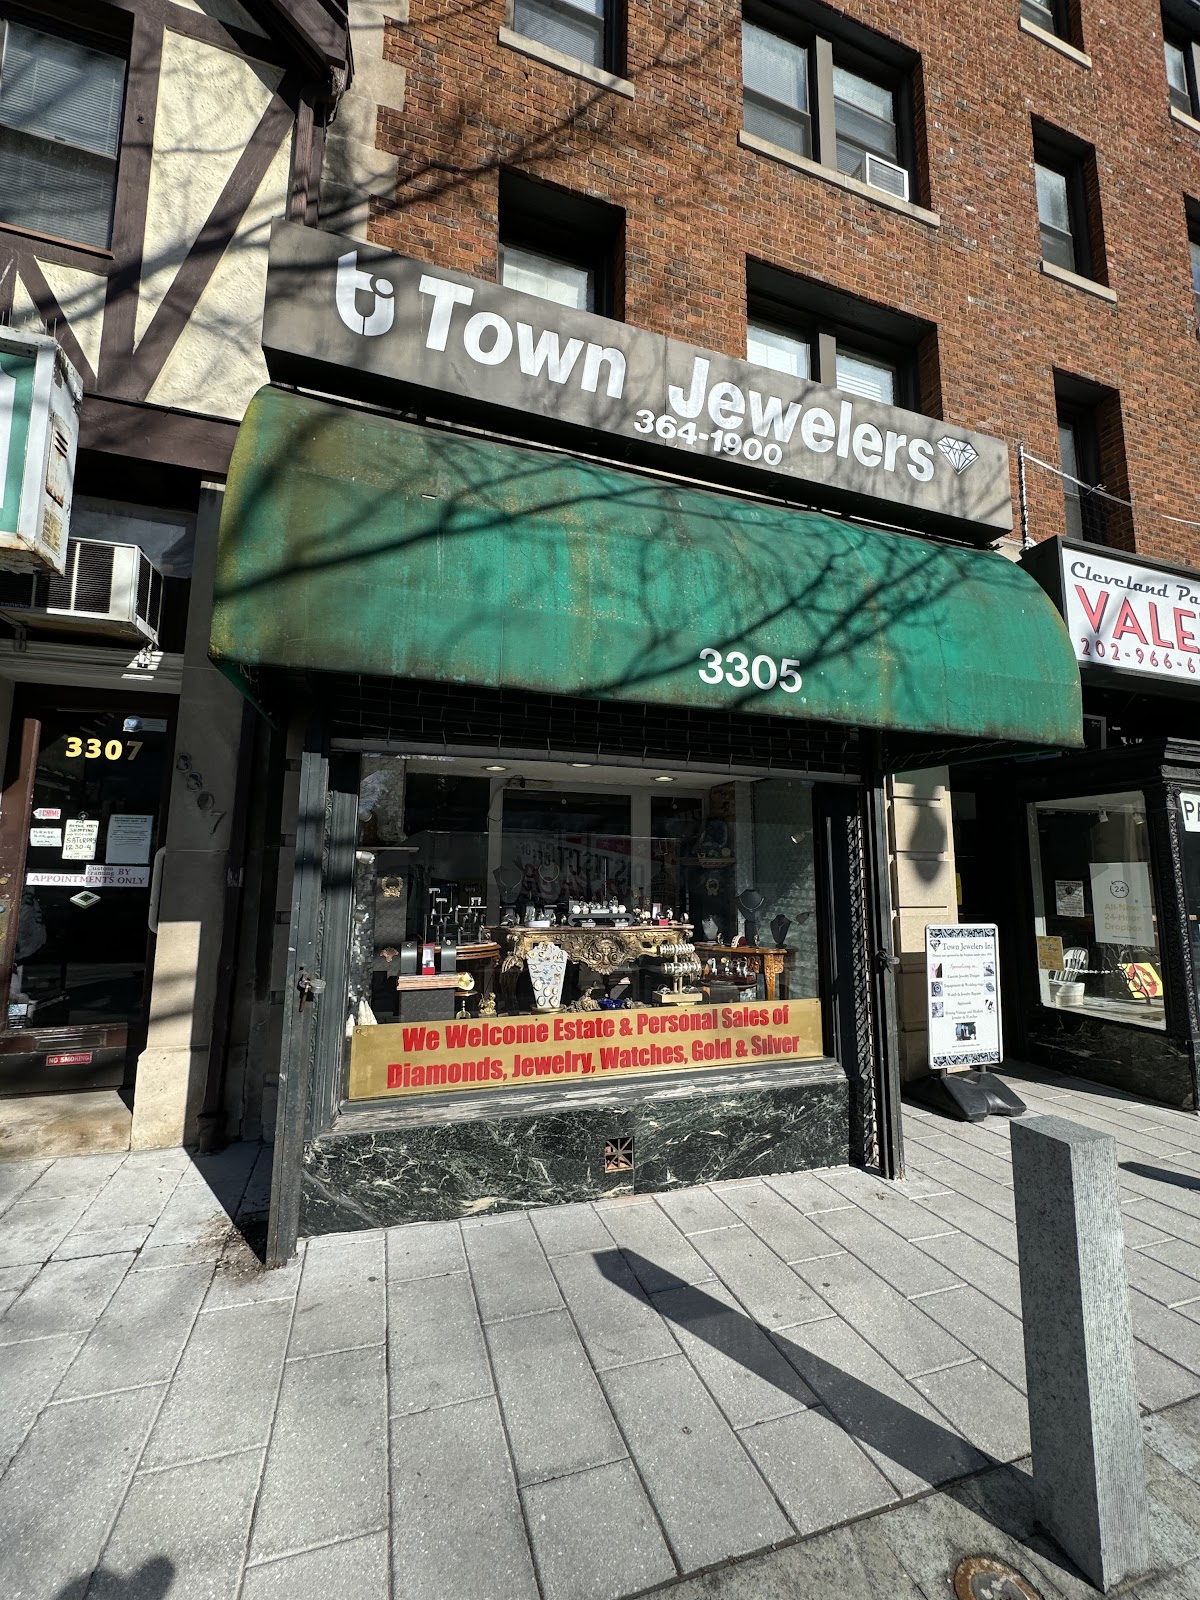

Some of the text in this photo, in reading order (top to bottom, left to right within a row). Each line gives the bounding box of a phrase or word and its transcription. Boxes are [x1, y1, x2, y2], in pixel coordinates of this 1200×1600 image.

[419, 274, 935, 482] Town Jewelers
[634, 409, 782, 466] 364-1900
[1070, 561, 1169, 598] Cleveland
[1074, 584, 1200, 655] VALE
[698, 648, 803, 693] 3305
[1081, 637, 1200, 673] 202-966-6
[65, 737, 143, 760] 3307
[117, 877, 145, 885] ONLY
[1114, 885, 1125, 893] 24
[960, 943, 983, 951] Jewelers
[403, 1005, 789, 1052] We Welcome Estate & Personal Sales of
[48, 1056, 58, 1064] NO
[387, 1034, 800, 1089] Diamonds, Jewelry, Watches, Gold & Silver
